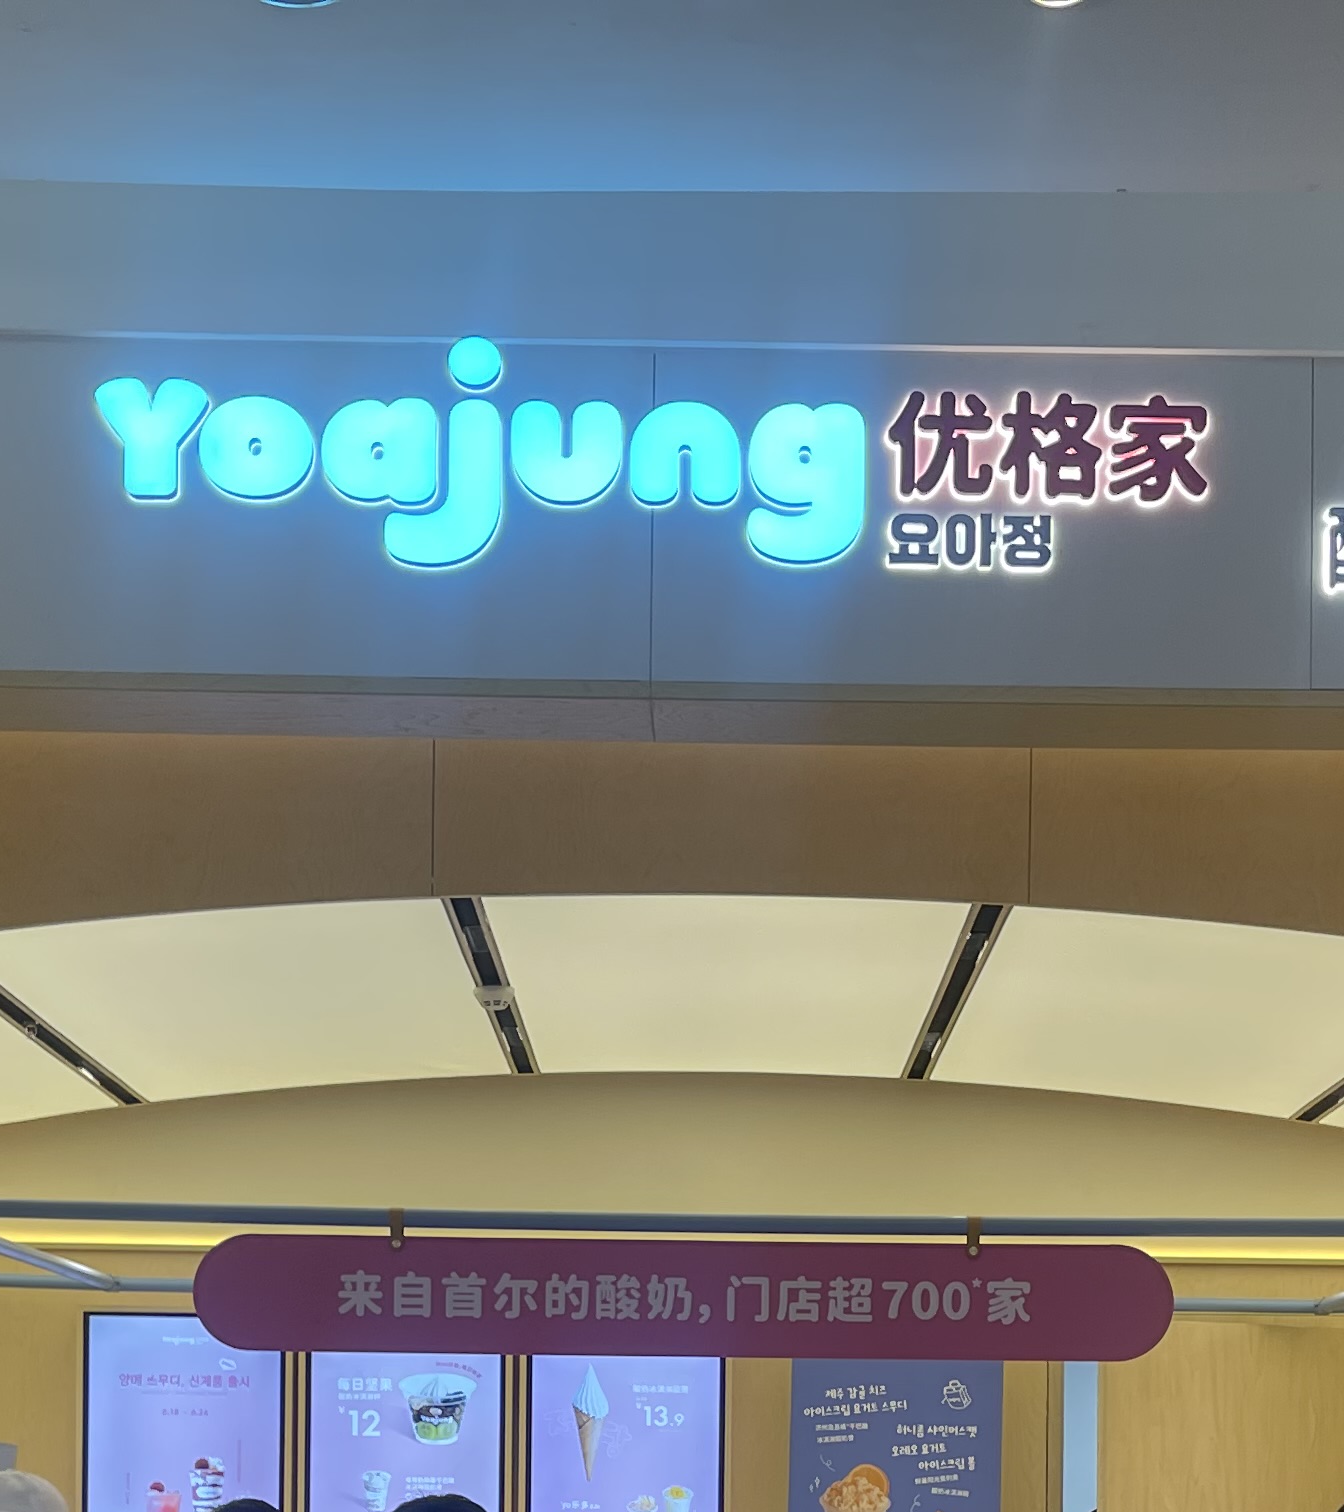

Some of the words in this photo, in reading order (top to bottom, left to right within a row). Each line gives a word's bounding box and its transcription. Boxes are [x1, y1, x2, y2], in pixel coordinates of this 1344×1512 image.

[93, 335, 867, 568] Yoajung
[886, 388, 1212, 504] 优格家
[885, 511, 1054, 572] 요아정
